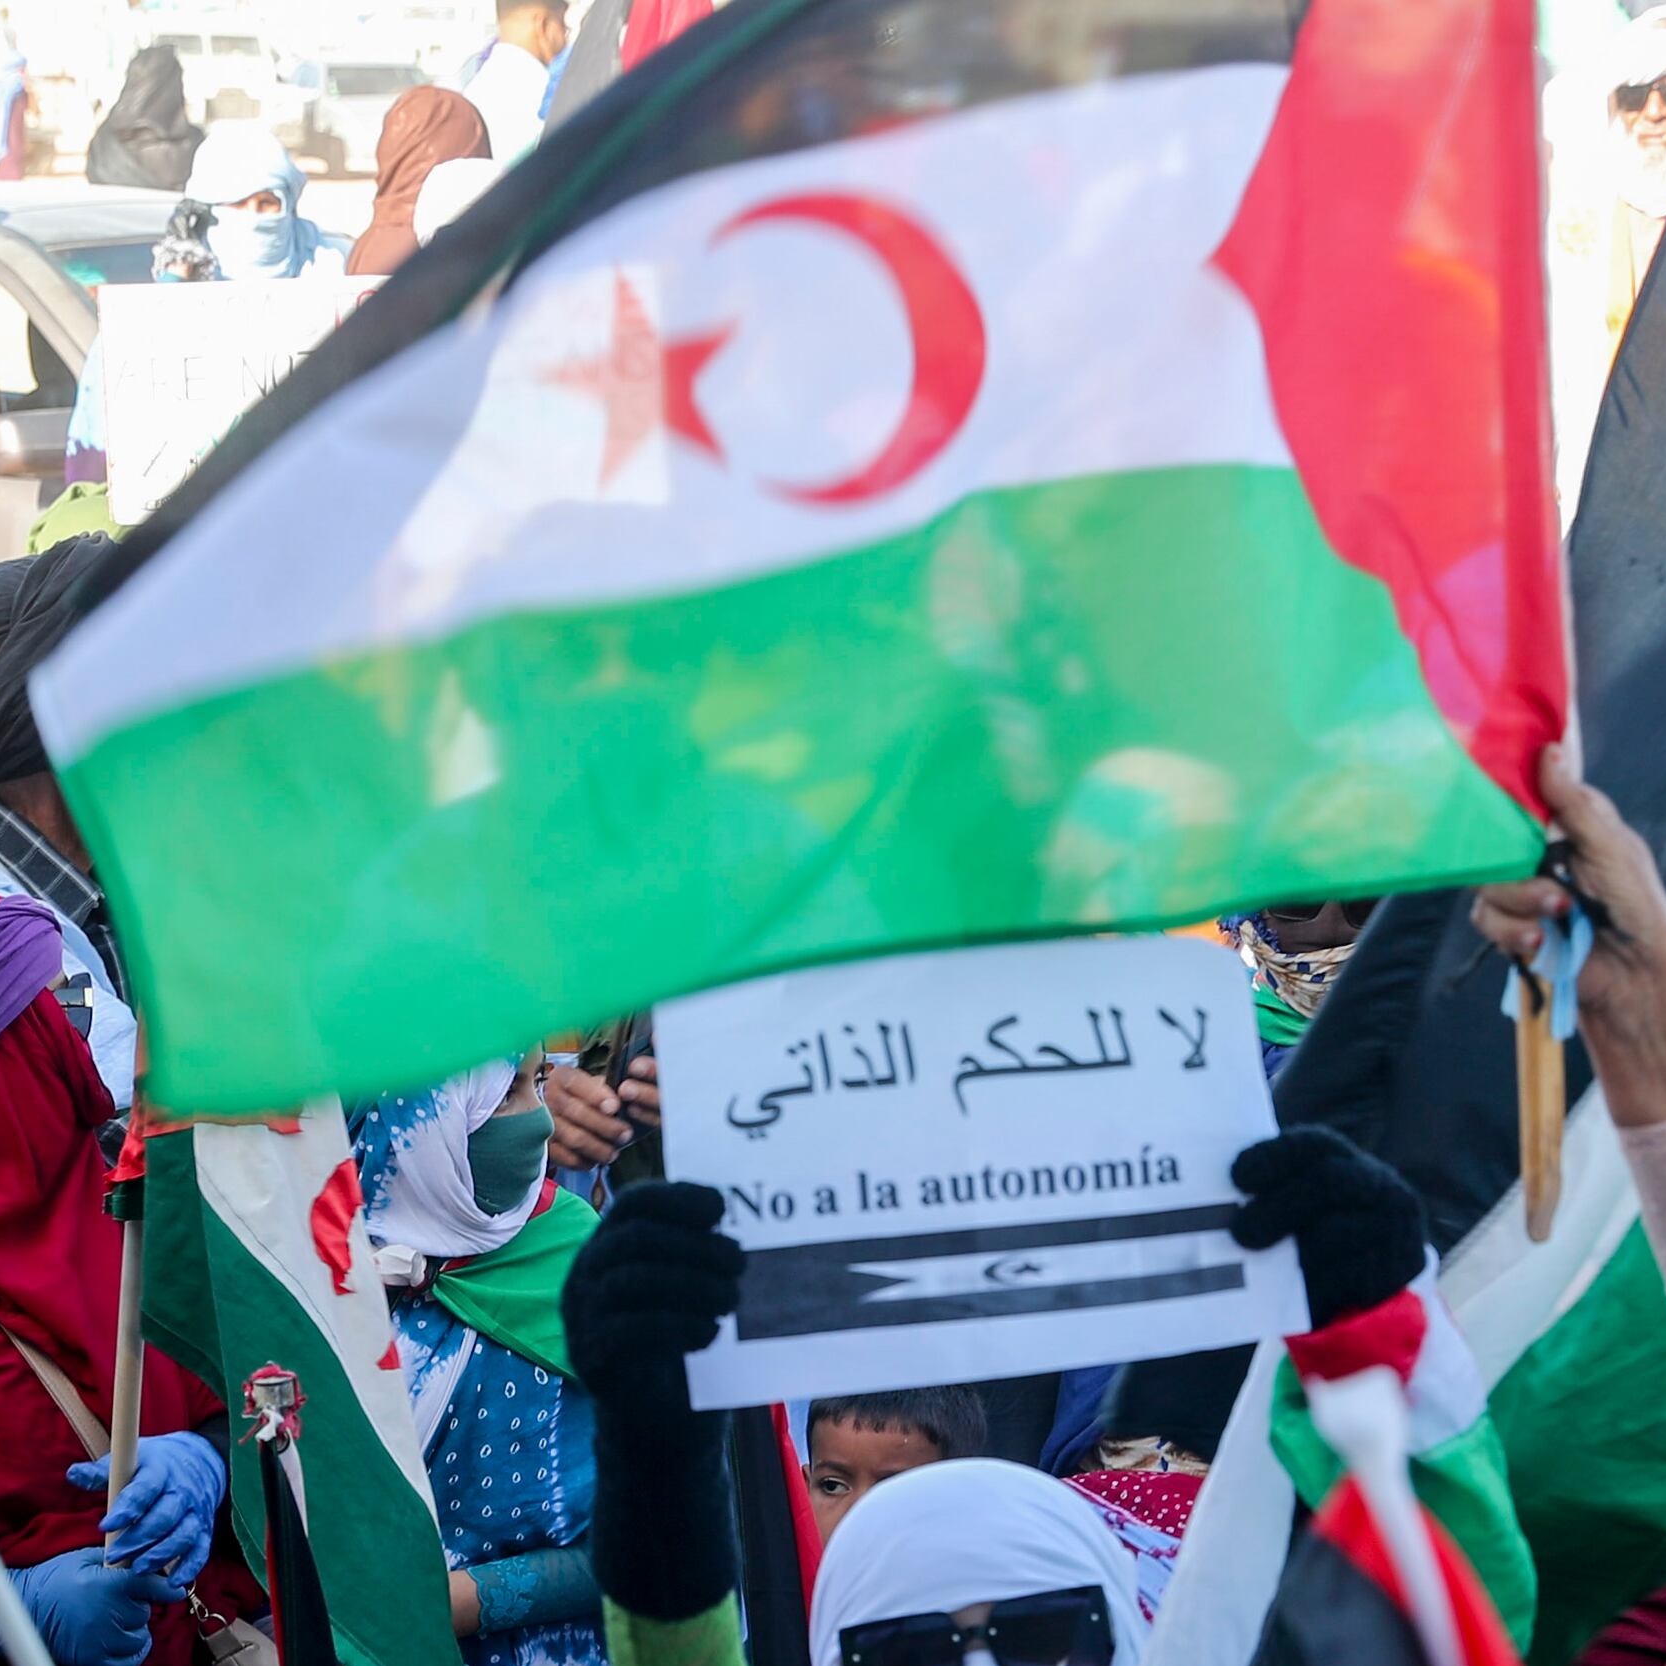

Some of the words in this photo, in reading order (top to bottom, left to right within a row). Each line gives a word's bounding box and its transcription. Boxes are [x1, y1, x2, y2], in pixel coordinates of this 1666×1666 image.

[726, 1021, 919, 1140] الذاتي
[953, 1006, 1134, 1115] للحكم
[1158, 1007, 1209, 1071] لا
[728, 1180, 796, 1227] No
[813, 1188, 841, 1216] a
[858, 1171, 902, 1213] la
[919, 1144, 1183, 1207] autonomía
